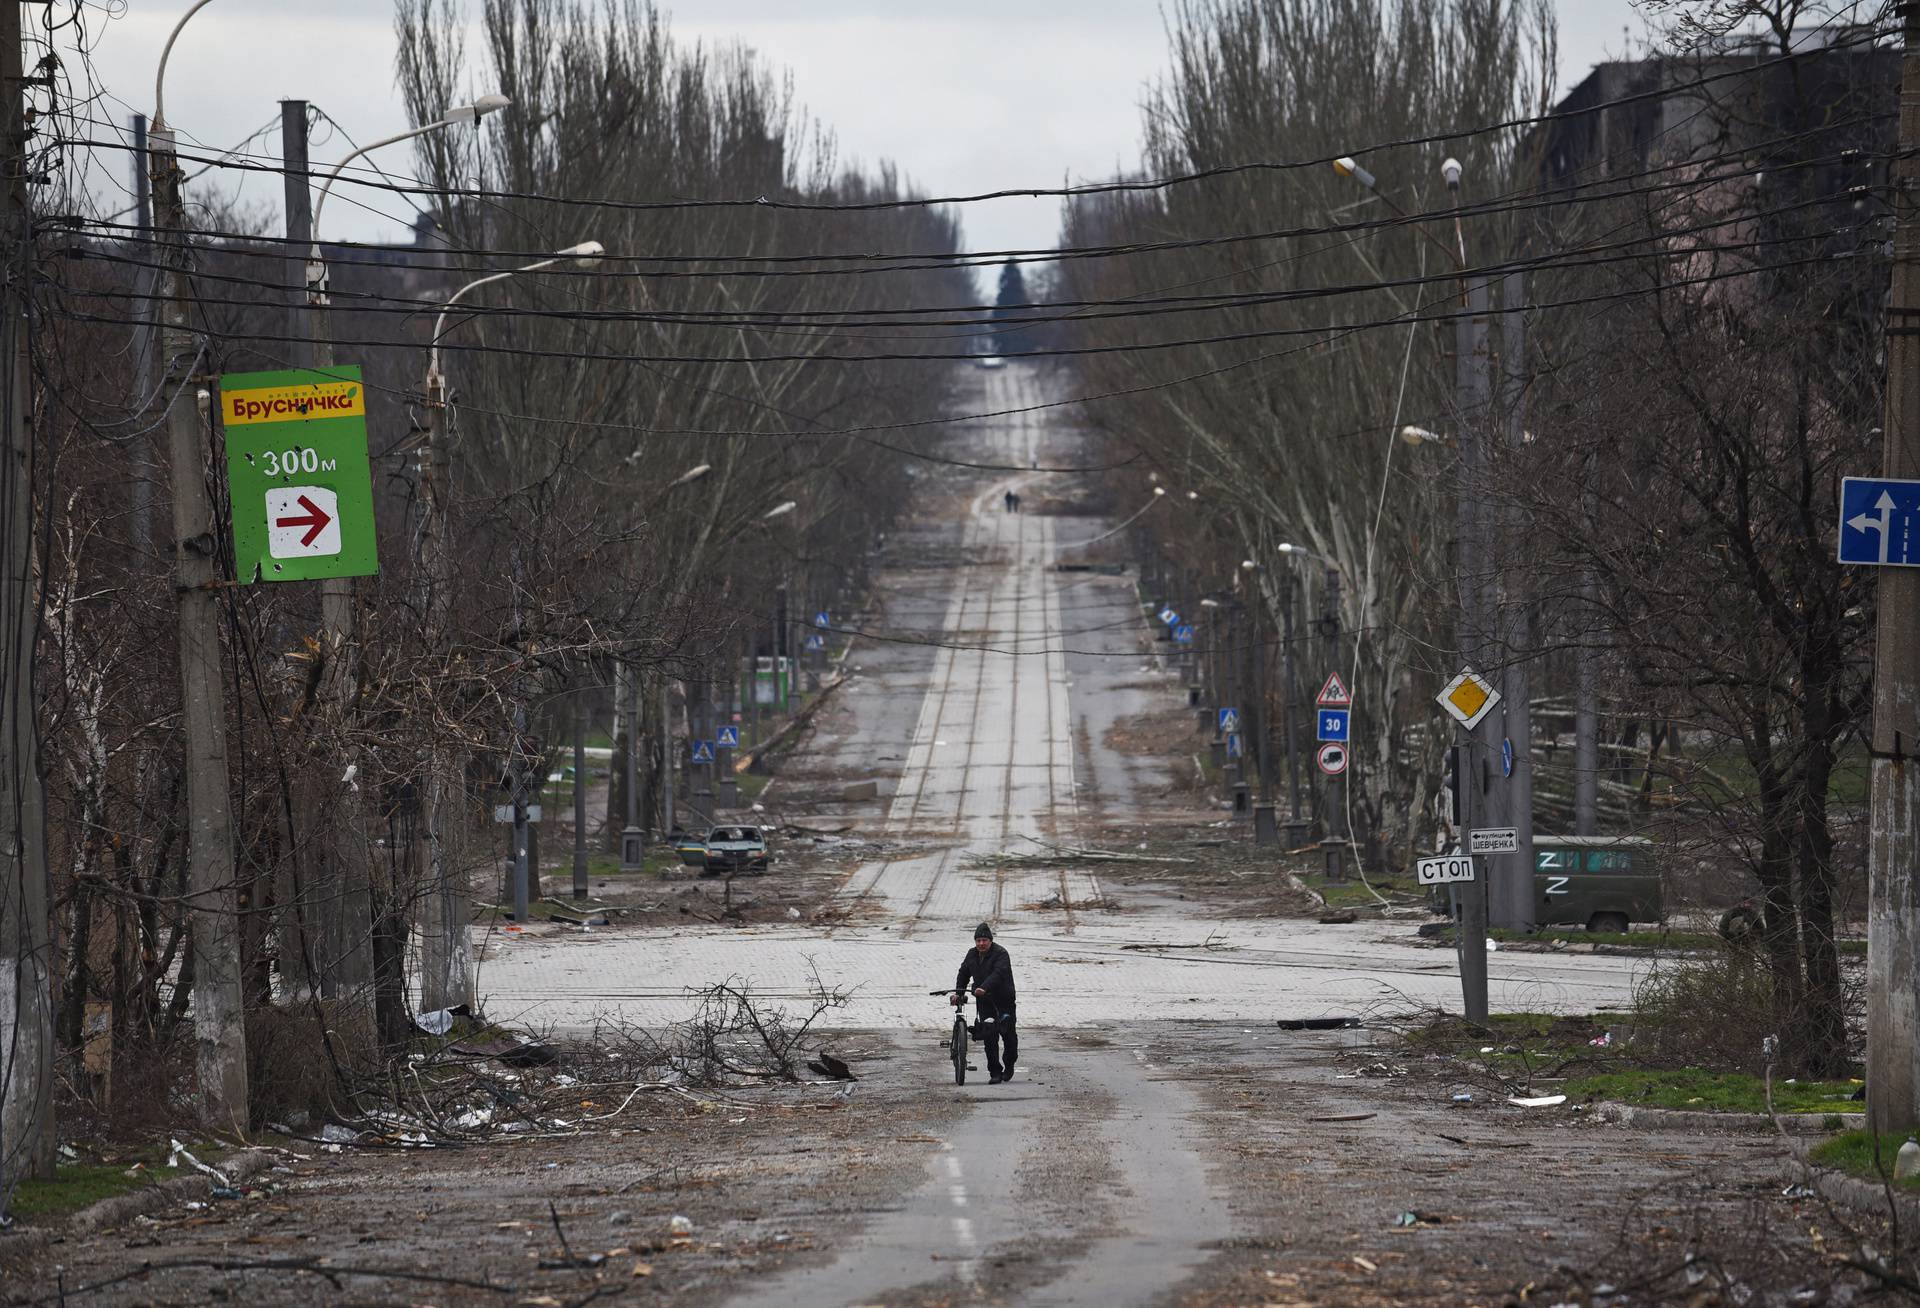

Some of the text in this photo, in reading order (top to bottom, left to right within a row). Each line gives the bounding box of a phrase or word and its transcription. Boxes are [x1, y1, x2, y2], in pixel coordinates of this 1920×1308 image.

[233, 395, 353, 419] Брусничка
[1326, 718, 1341, 731] 30
[1472, 840, 1514, 850] ШЕВЧЕНКА
[1540, 852, 1563, 868] Z
[1423, 861, 1470, 879] СТОП
[1546, 877, 1569, 894] Z
